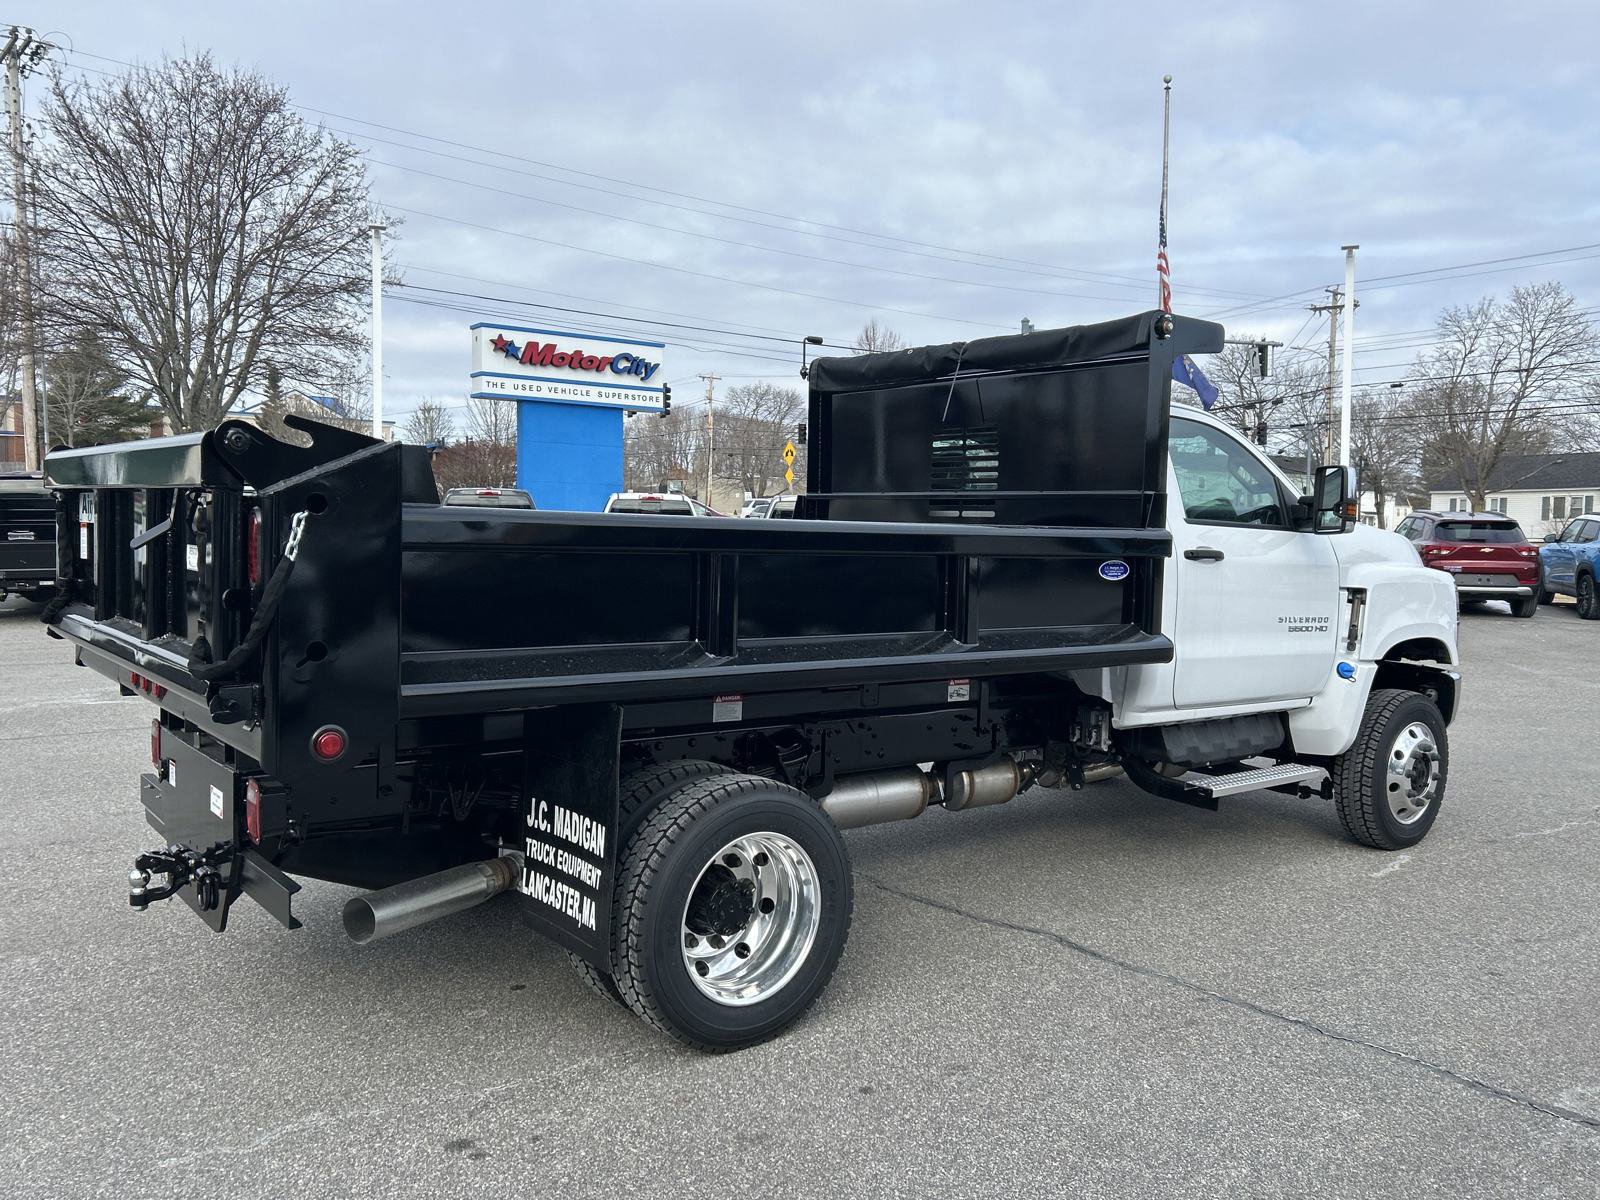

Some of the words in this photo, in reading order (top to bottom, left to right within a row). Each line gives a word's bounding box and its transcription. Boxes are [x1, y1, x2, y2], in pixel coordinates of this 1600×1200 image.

[519, 341, 661, 381] MotorCity
[485, 380, 506, 389] THE
[513, 383, 543, 392] USED
[547, 386, 591, 397] VEHICLE
[597, 390, 661, 403] SUPERSTORE
[1278, 616, 1329, 624] SILVERADO
[1314, 625, 1328, 633] HD
[526, 797, 551, 833] J.C.
[554, 805, 606, 858] MADIGAN
[525, 837, 556, 866] TRUCK
[556, 849, 602, 890] EQUIPMENT
